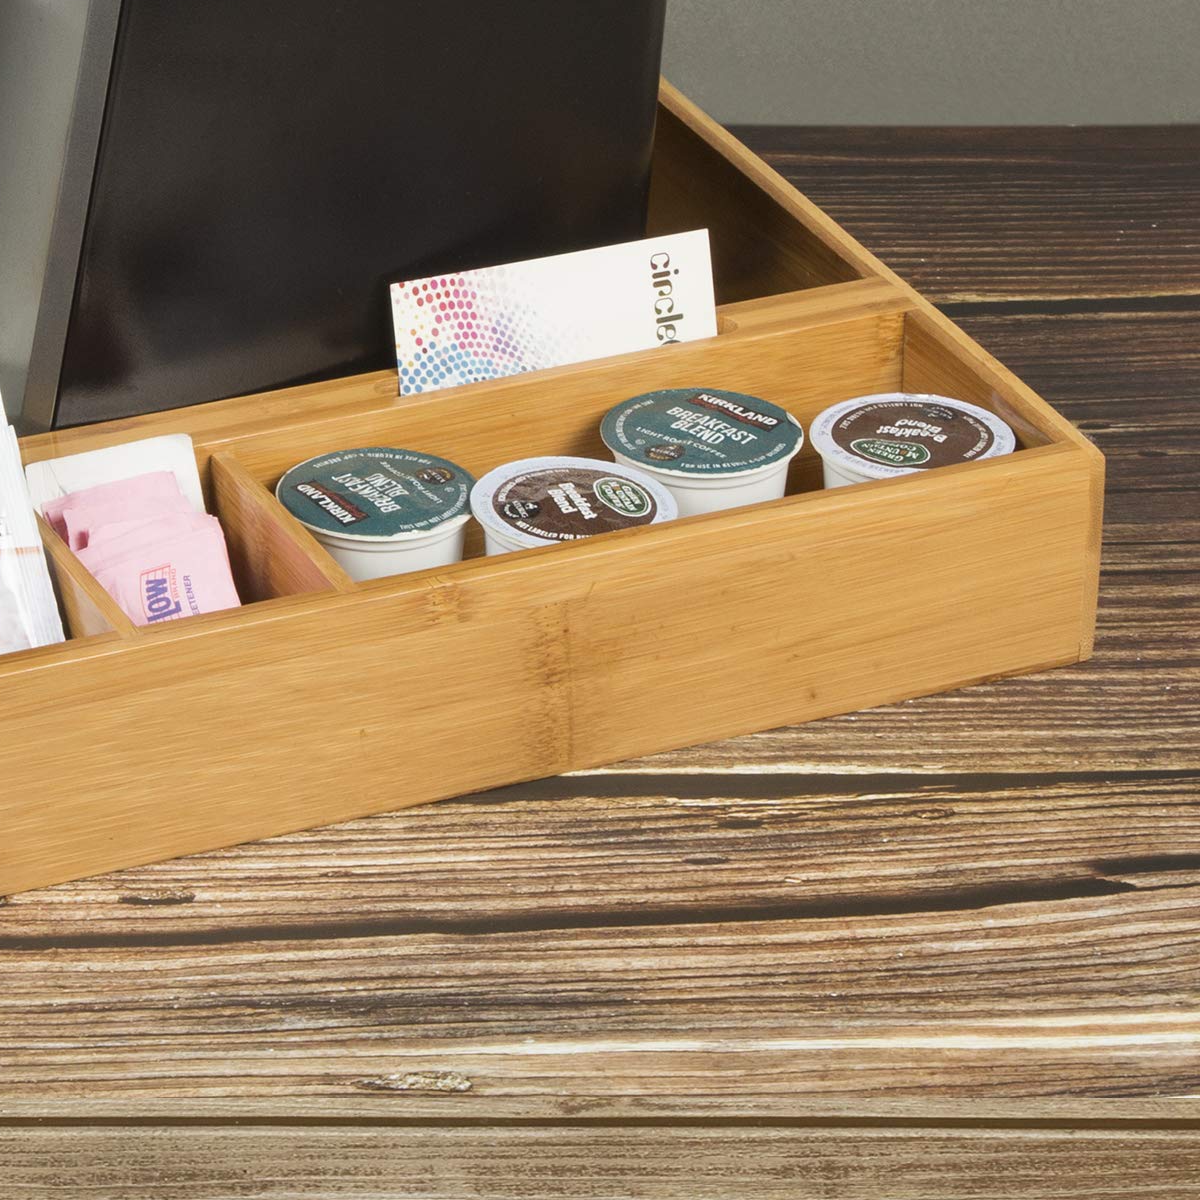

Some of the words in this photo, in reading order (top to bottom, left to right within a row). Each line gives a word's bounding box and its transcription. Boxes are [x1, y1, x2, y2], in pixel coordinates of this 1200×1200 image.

[666, 406, 758, 445] BREAKFAST
[698, 393, 779, 427] KIRKLAND
[894, 418, 942, 435] Blend
[636, 426, 663, 441] LIGHT
[693, 442, 727, 459] COFFEE
[670, 419, 726, 445] BLEND
[876, 424, 948, 443] Breakfast
[866, 446, 905, 462] GREEN
[331, 473, 402, 514] BREAKFAST
[367, 472, 410, 497] BLEND
[547, 488, 578, 514] Blend
[558, 482, 598, 520] Breakfast
[297, 484, 357, 525] KIRKLAND
[146, 578, 182, 622] LOW
[183, 575, 200, 616] EETENER
